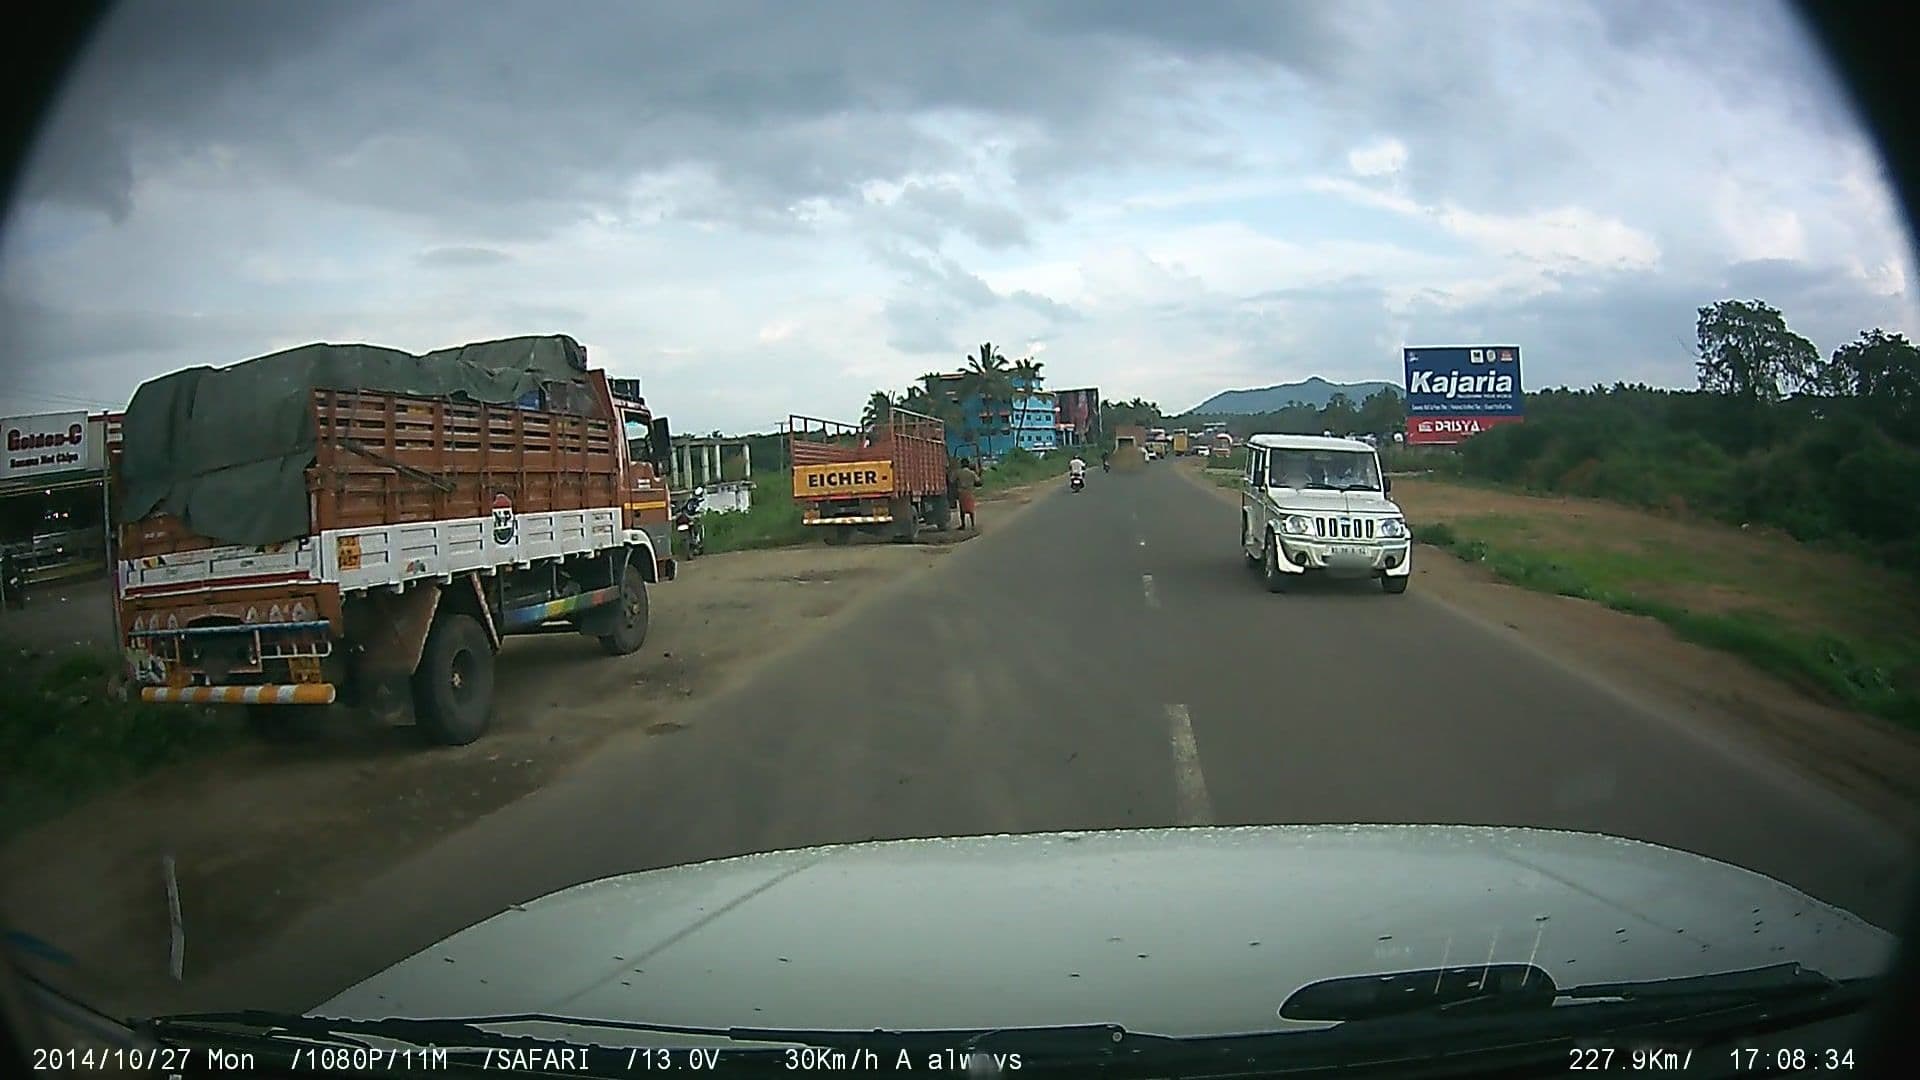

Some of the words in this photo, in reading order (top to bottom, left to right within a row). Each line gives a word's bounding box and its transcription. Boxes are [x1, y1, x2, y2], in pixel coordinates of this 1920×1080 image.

[1410, 370, 1513, 399] Kajaria
[1435, 420, 1481, 432] DRISYA
[808, 470, 877, 488] EICHER
